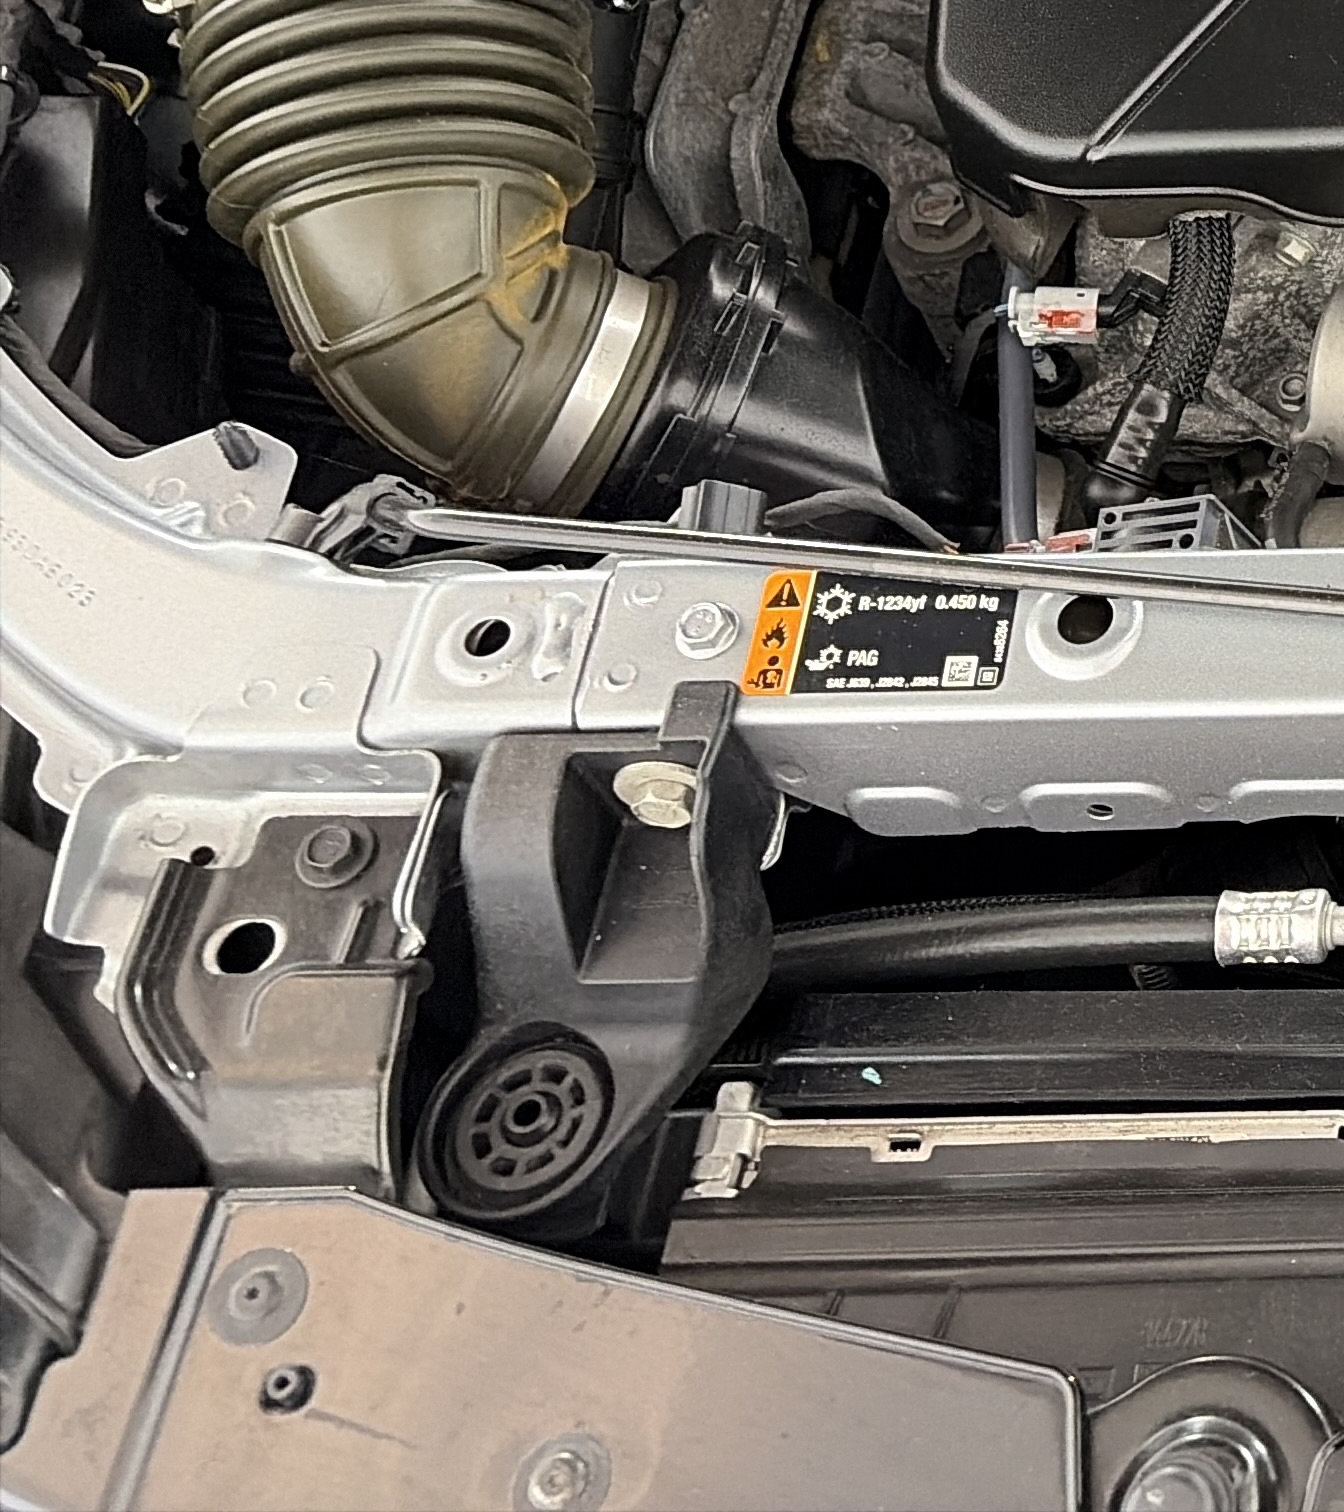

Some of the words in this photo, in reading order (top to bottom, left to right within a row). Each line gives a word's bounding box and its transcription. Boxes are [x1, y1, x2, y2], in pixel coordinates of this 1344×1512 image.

[858, 595, 928, 614] R-1234yf
[935, 595, 977, 610] 0.450
[978, 595, 999, 614] kg
[847, 650, 879, 667] PAG
